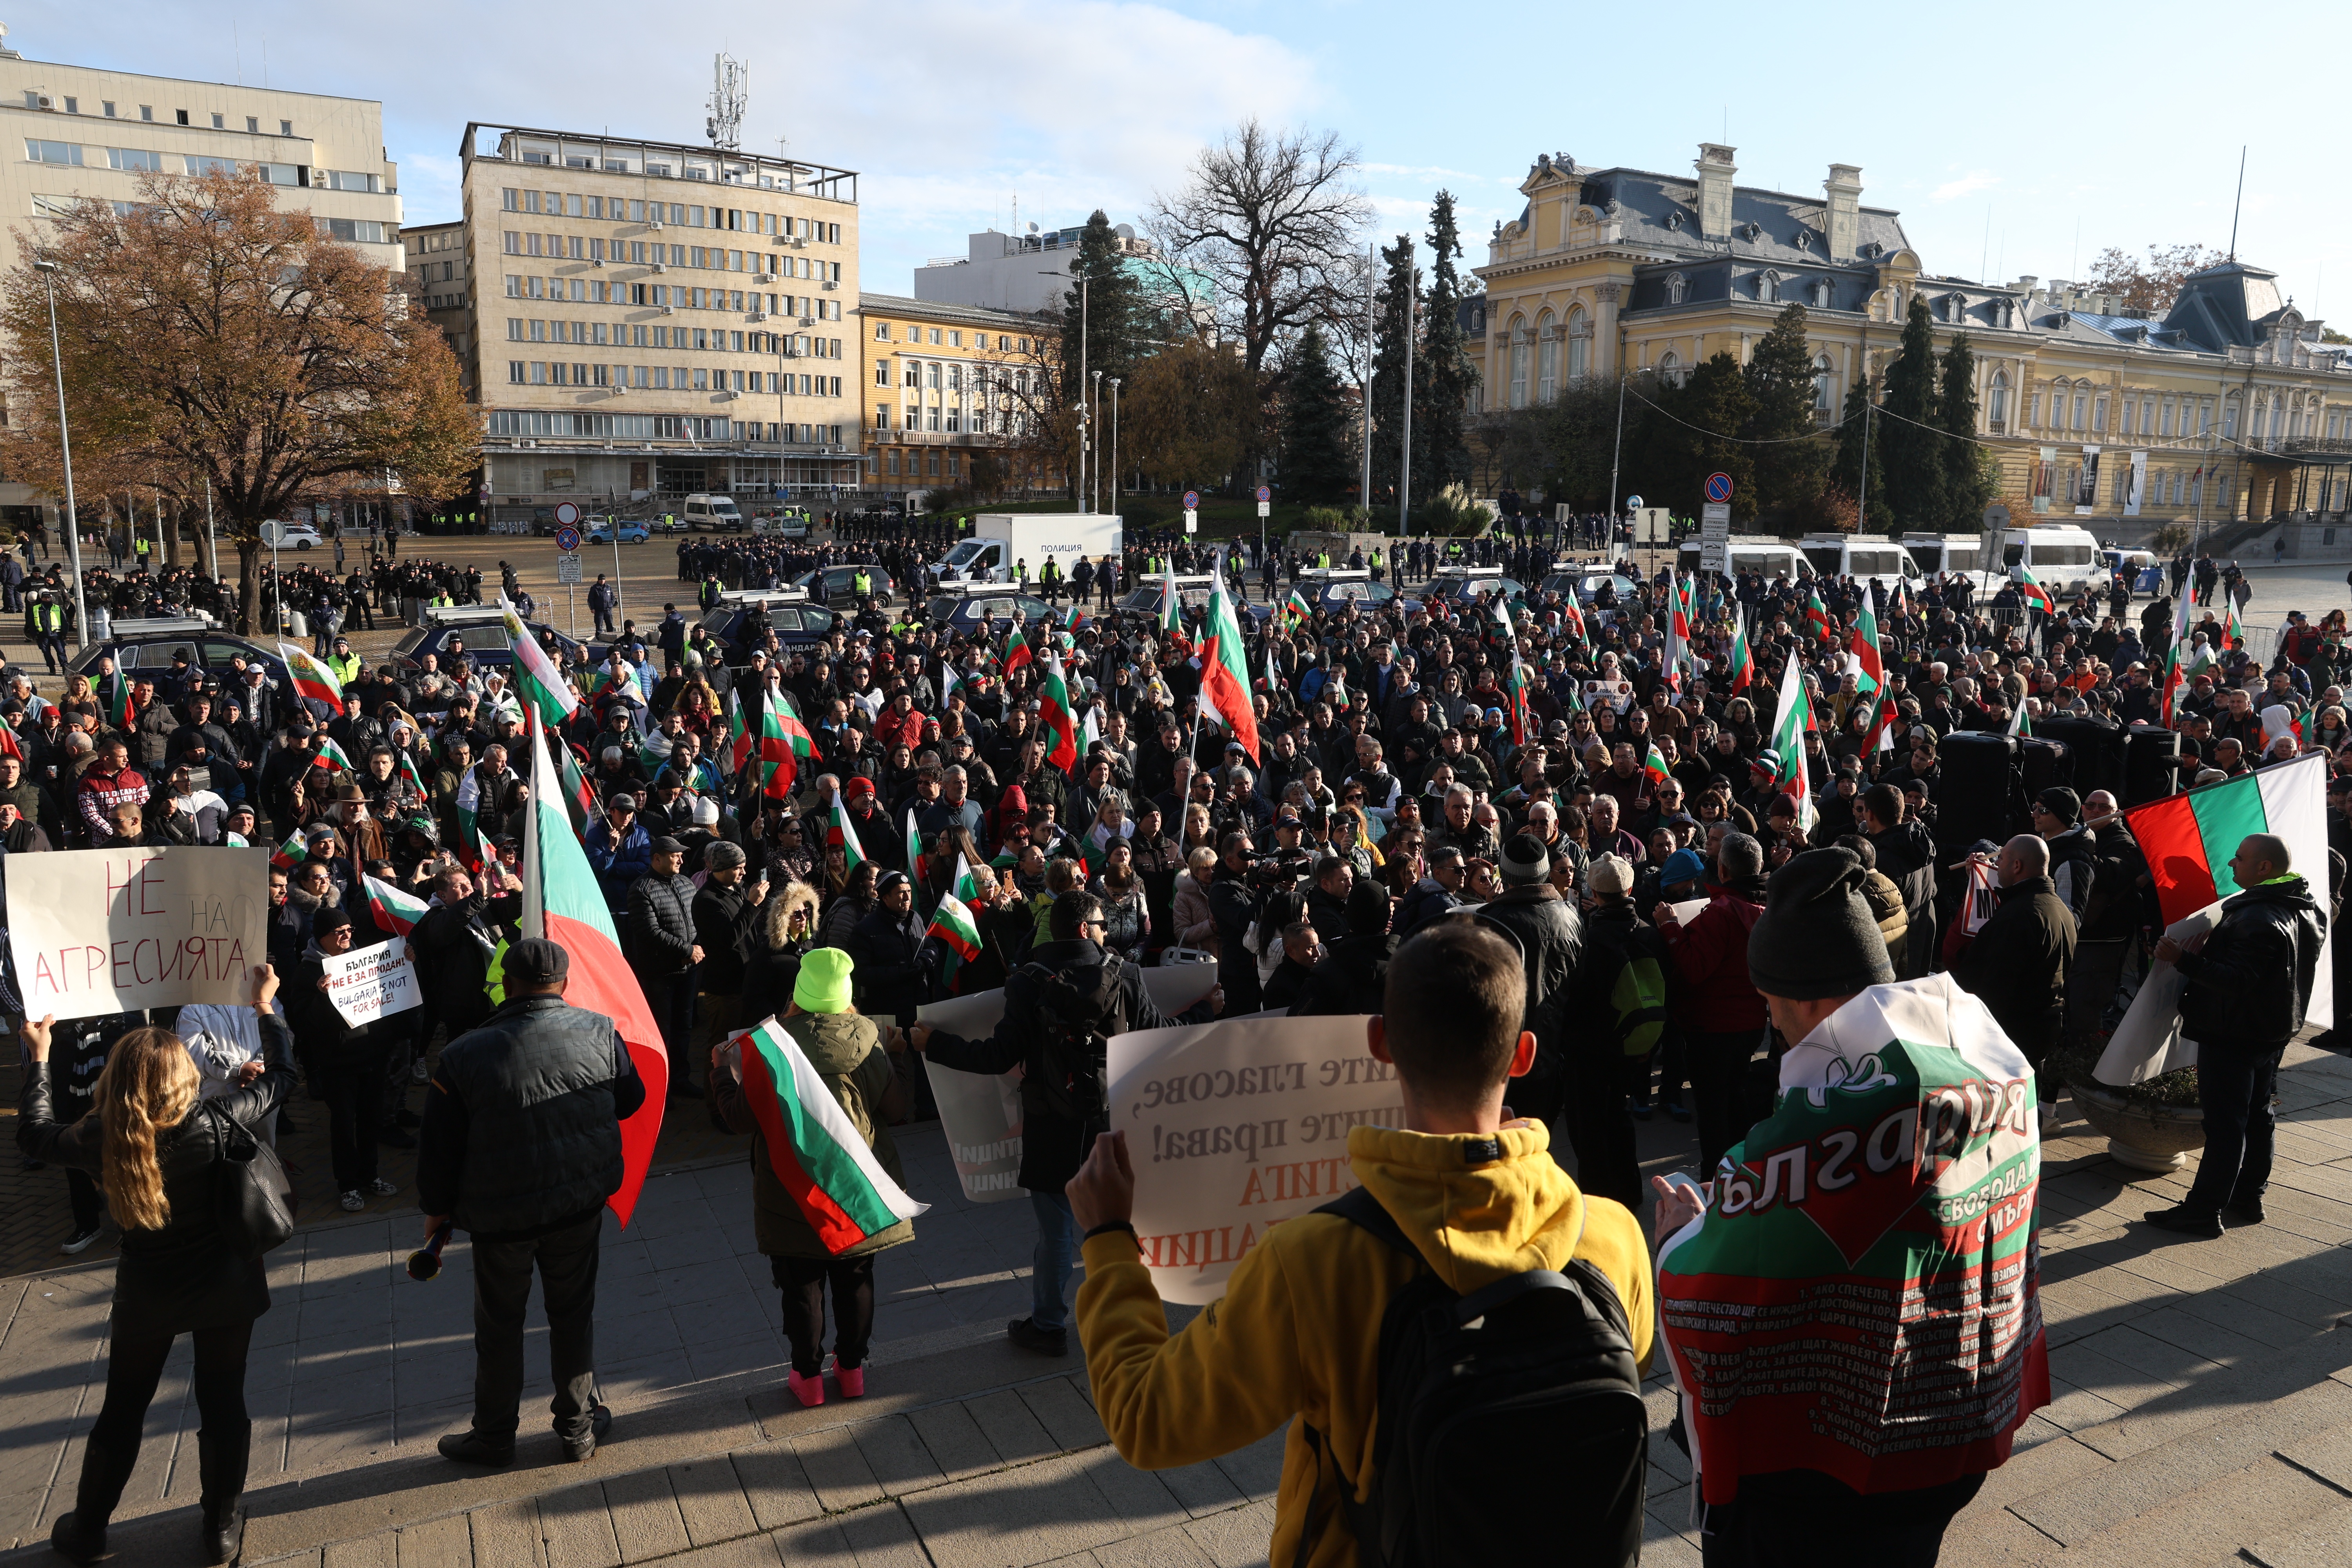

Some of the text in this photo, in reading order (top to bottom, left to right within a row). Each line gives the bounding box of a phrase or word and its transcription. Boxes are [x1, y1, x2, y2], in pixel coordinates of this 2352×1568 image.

[107, 858, 165, 916] НЕ
[192, 900, 229, 933] НА
[36, 936, 247, 996] АГРЕСИЯТА
[332, 957, 405, 989] НЕ Е ЗА ПРОДАН!
[346, 949, 391, 972] БЪЛГАРИЯ
[339, 975, 407, 1007] BULGARIA IS NOT
[354, 992, 394, 1016] FOR SALE!
[1705, 1084, 2027, 1215] ългария
[1938, 1161, 2027, 1224] СВОБОДА
[1976, 1187, 2034, 1243] СМЪРТ
[1800, 1289, 1809, 1299] 1.
[1812, 1283, 1835, 1296] "АКО
[1838, 1284, 1892, 1303] СПЕЧЕЛЯ,
[2000, 1263, 2019, 1282] ЗАГУБЯ,
[1698, 1302, 1741, 1316] ОТЕЧЕСТВО
[1741, 1305, 1757, 1318] ЩЕ
[1758, 1307, 1768, 1318] СЕ
[1807, 1300, 1818, 1310] ОТ
[1819, 1298, 1869, 1314] ДОСТОЙНИ
[1872, 1303, 1900, 1320] ХОРА,
[1900, 1303, 1920, 1319] КОИТО
[1708, 1319, 1739, 1335] НАРОД,
[1755, 1318, 1790, 1331] ВЯРАТА
[1807, 1312, 1813, 1322] А
[1820, 1312, 1846, 1324] ЦАРЯ
[1848, 1316, 1855, 1326] И
[1860, 1334, 1870, 1345] 4.
[1922, 1328, 1955, 1342] СЪСТОИ
[1720, 1353, 1741, 1367] НЕЯ
[1802, 1339, 1828, 1352] ЩАТ
[1829, 1341, 1878, 1362] ЖИВЕЯТ
[1924, 1344, 1951, 1357] ЧИСТИ
[1774, 1356, 1785, 1367] ЗА
[1788, 1354, 1843, 1367] ВСИЧКИТЕ
[1846, 1359, 1891, 1382] ЕДНАКВ
[1915, 1361, 1938, 1375] САМО
[1773, 1367, 1807, 1381] ПАРИТЕ
[1807, 1365, 1848, 1384] ДЪРЖАТ
[1850, 1374, 1857, 1386] И
[1915, 1375, 1942, 1390] ЗАЩОТО
[1943, 1373, 1960, 1385] ТЕЗИ
[1782, 1379, 1817, 1394] БАЙО!
[1820, 1381, 1855, 1402] КАЖИ
[1858, 1394, 1873, 1408] ТИ
[1917, 1393, 1928, 1405] АЗ
[1820, 1396, 1831, 1406] 8.
[1833, 1399, 1851, 1414] "ЗА
[1808, 1408, 1819, 1419] 9.
[1822, 1410, 1862, 1434] "КОИТО
[1891, 1427, 1904, 1440] ДА
[1906, 1423, 1936, 1436] УМРАТ
[1936, 1421, 1946, 1432] ЗА
[1812, 1422, 1829, 1437] 10.
[1882, 1438, 1924, 1454] ВСЕКИГО,
[1926, 1435, 1942, 1447] БЕЗ
[1942, 1435, 1956, 1446] ДА
